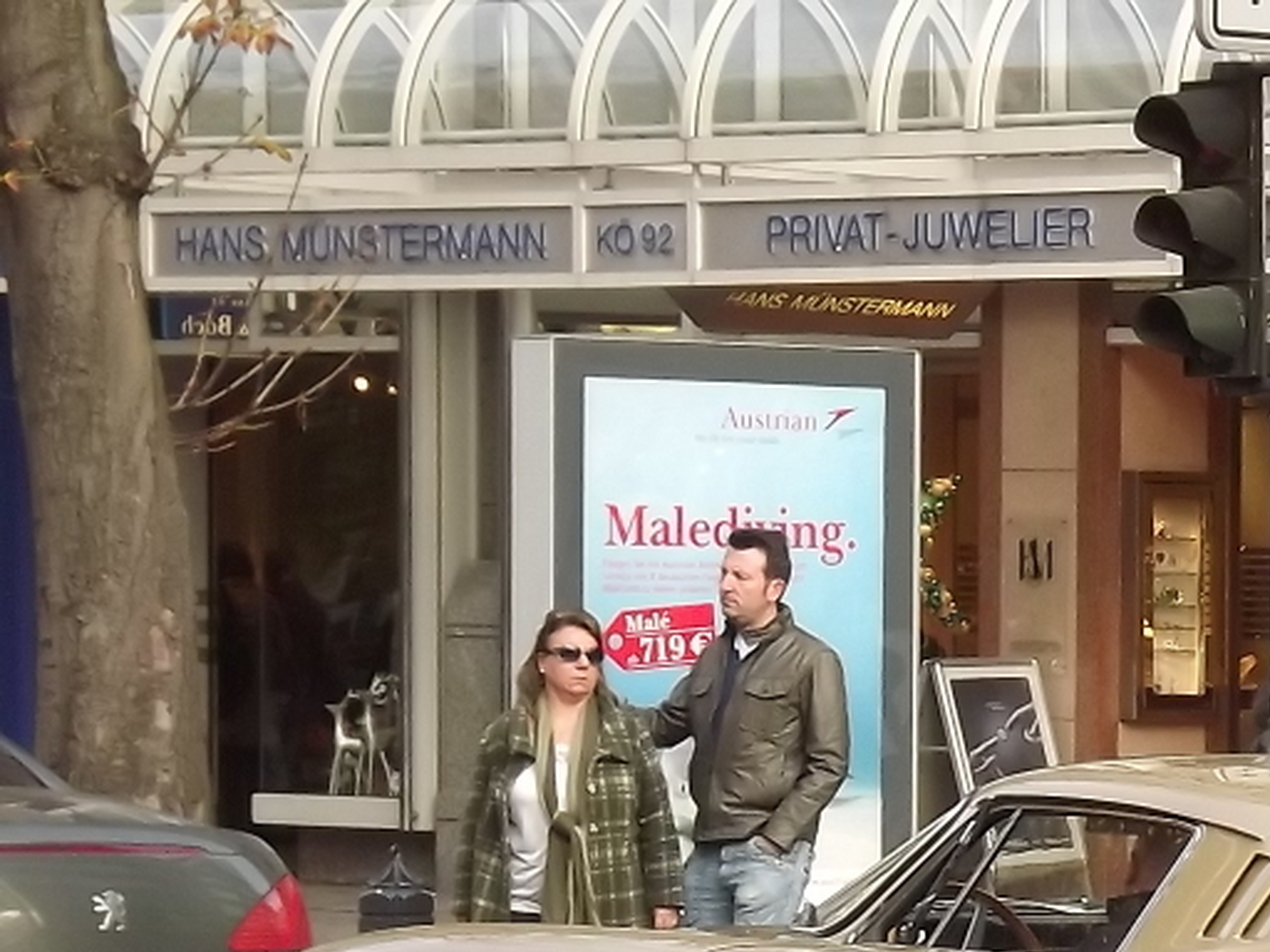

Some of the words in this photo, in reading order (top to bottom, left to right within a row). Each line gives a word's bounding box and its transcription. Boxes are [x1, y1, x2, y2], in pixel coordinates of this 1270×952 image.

[175, 225, 267, 262] HANS
[641, 222, 676, 255] 92
[766, 206, 1094, 253] PRIVAT-JUWELIER
[726, 292, 789, 309] HANS
[791, 292, 957, 319] MÜNSTERMANN
[721, 406, 817, 432] Austrian
[624, 610, 671, 632] Malé
[639, 635, 686, 663] 719
